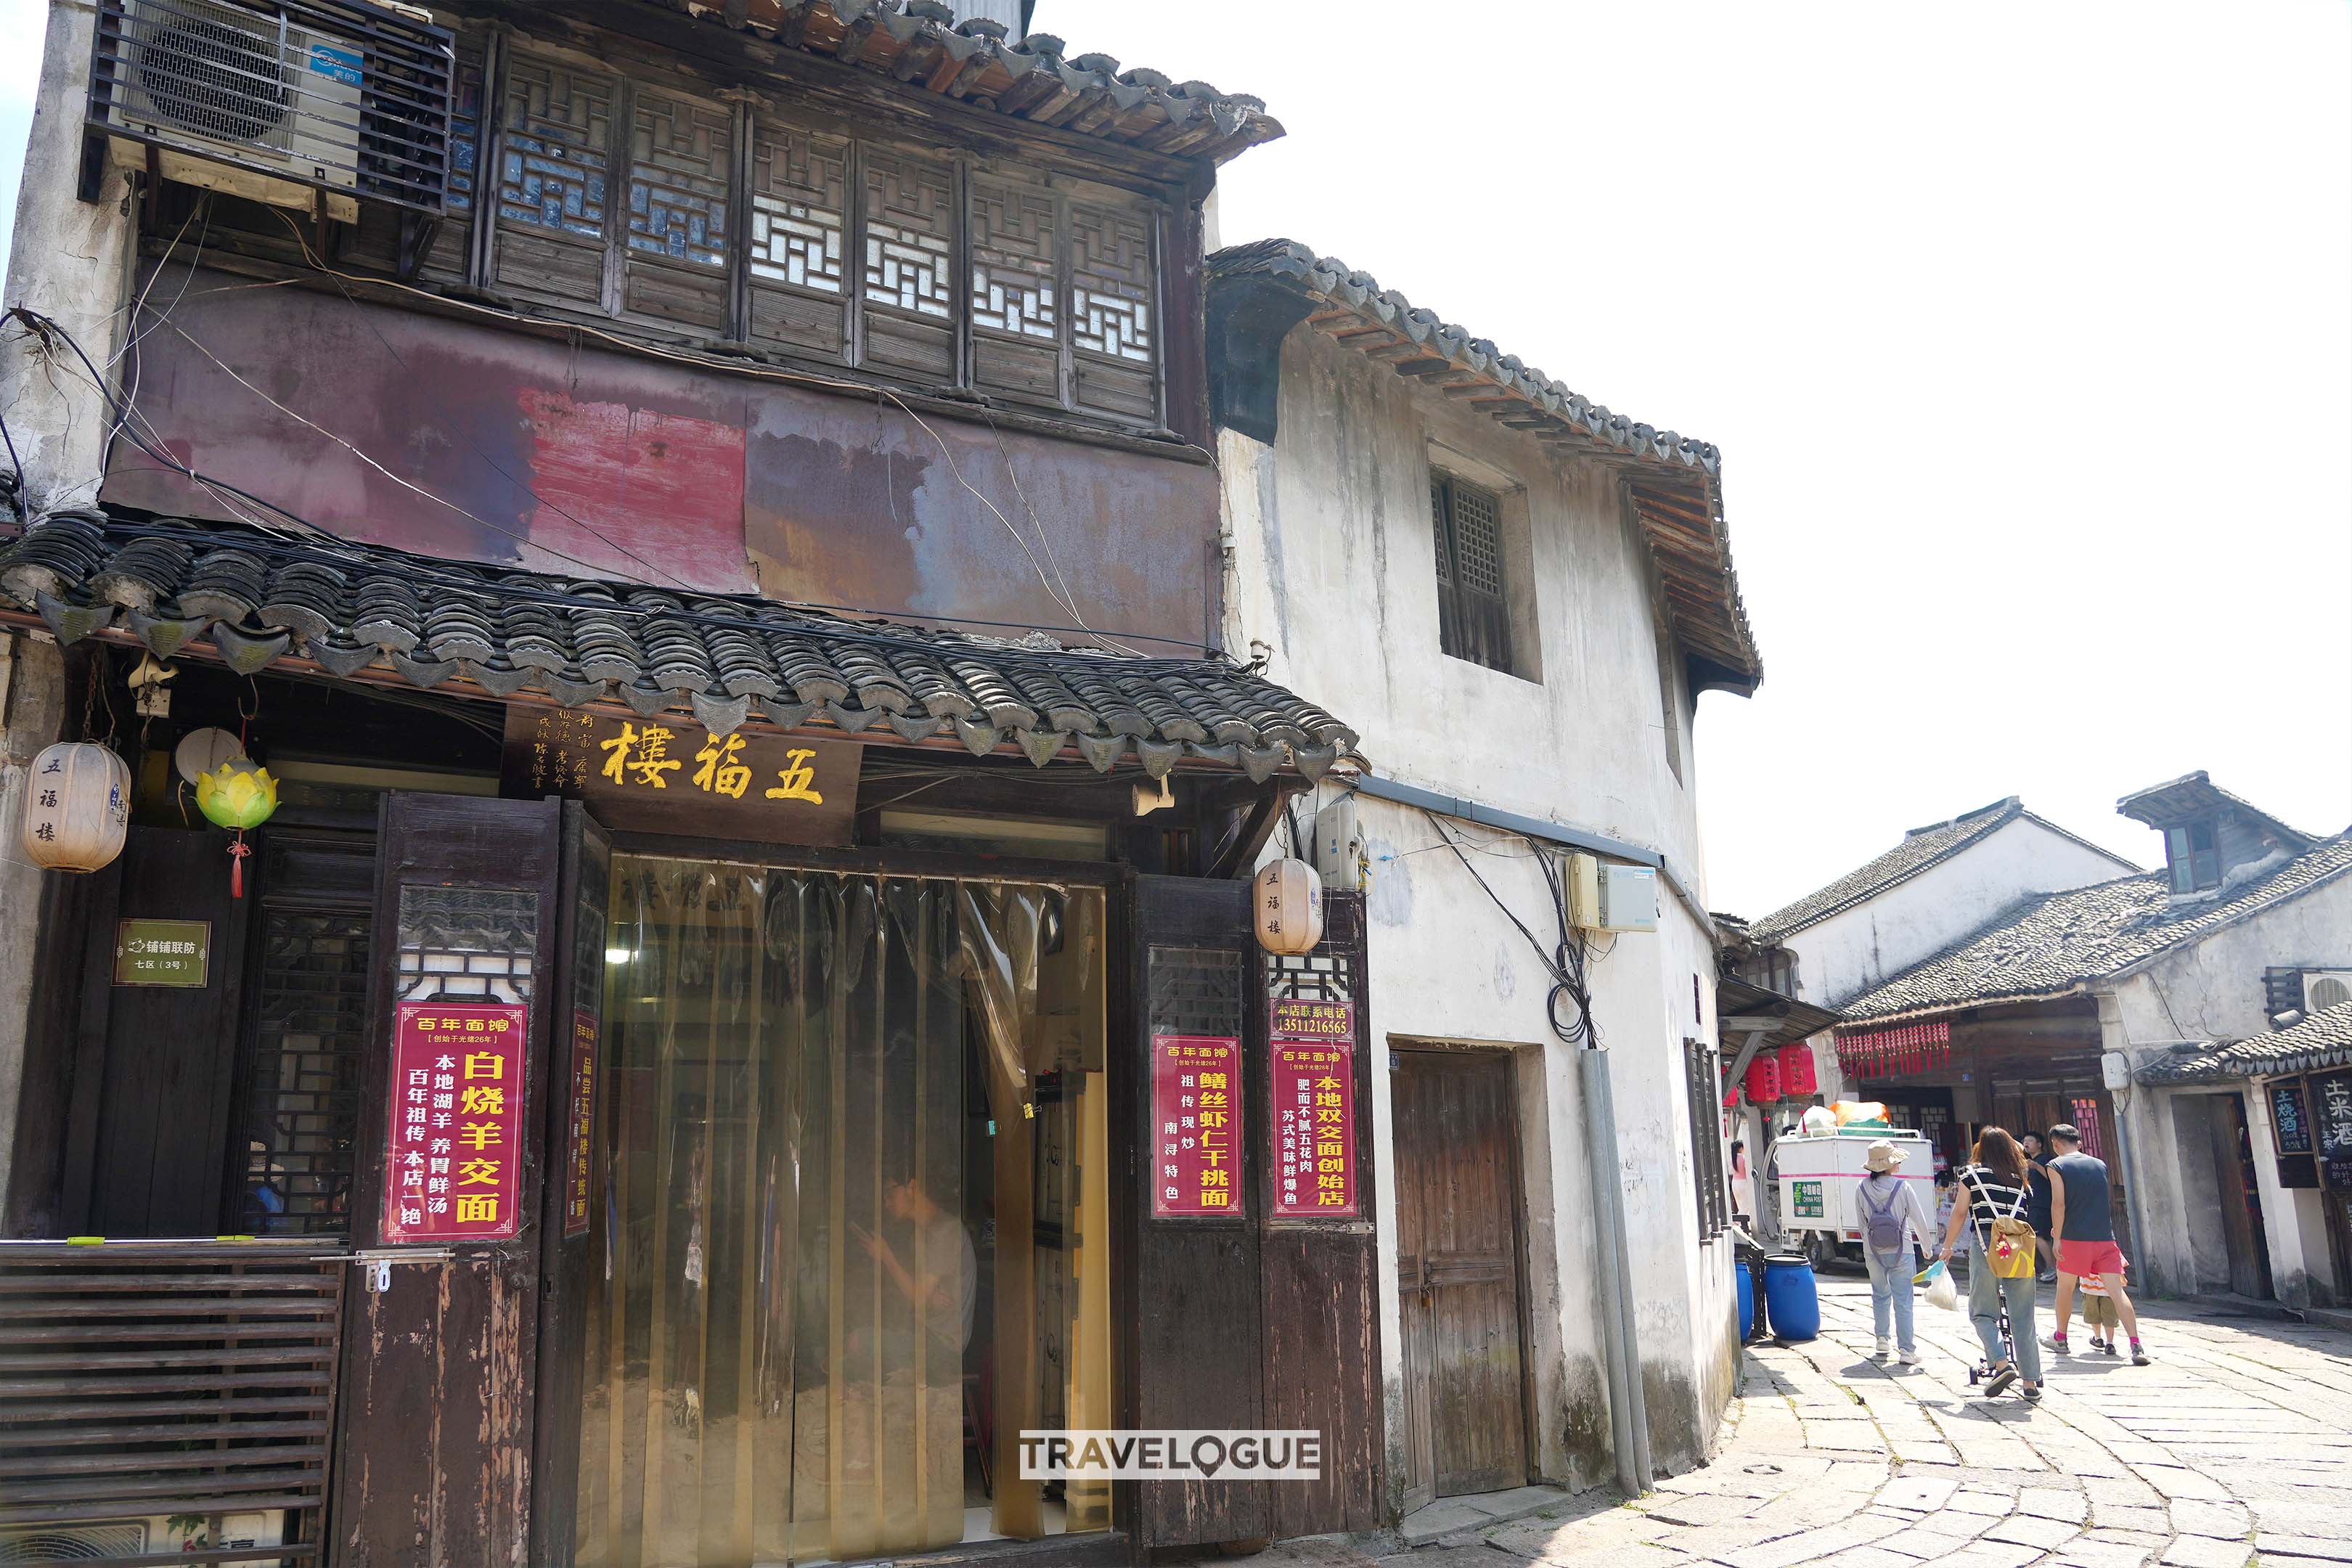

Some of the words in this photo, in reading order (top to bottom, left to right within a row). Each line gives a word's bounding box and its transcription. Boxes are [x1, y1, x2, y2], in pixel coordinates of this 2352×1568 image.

[36, 759, 61, 842] 五福楼
[1266, 873, 1281, 935] 五福楼
[146, 940, 196, 954] 铺铺联防
[417, 1018, 509, 1032] 百年面馆
[1277, 1004, 1346, 1019] 本店联系电话
[1278, 1018, 1347, 1034] 13511216565
[1167, 1046, 1228, 1058] 百年面馆
[1282, 1051, 1341, 1061] 百年面馆
[457, 1051, 505, 1223] 白烧羊交面
[1180, 1074, 1195, 1150] 祖传现炒
[1199, 1072, 1229, 1206] 鳝丝虾仁干挑面
[1297, 1078, 1312, 1173] 肥而不腻五花肉
[1314, 1076, 1344, 1206] 本地双交面创始店
[2277, 1090, 2298, 1132] 土烧酒
[1164, 1122, 1179, 1199] 南浔特色
[1281, 1109, 1297, 1205] 苏式美味鲜爆鱼
[1802, 1184, 1821, 1196] 中国邮政
